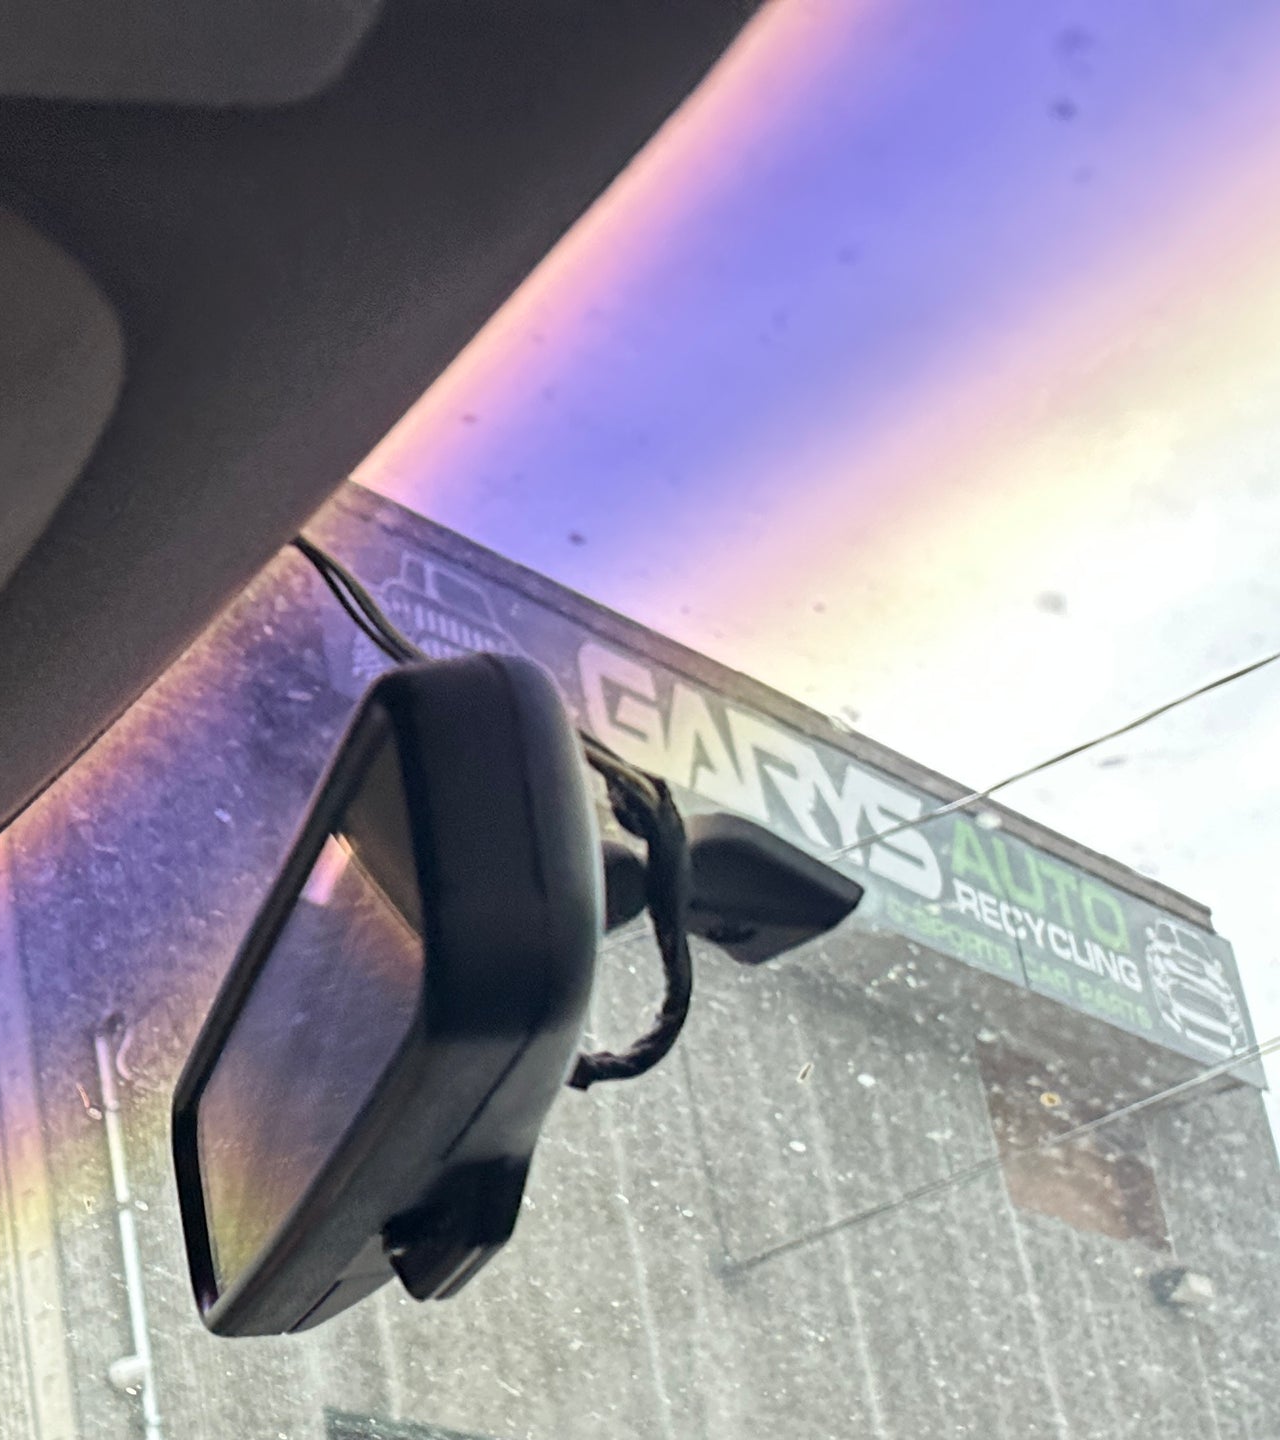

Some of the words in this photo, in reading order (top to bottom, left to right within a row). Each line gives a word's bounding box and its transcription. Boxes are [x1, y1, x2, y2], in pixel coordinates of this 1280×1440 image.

[578, 640, 942, 900] GARYS
[950, 818, 1132, 952] AUTO
[952, 876, 1144, 993] RECYCLING
